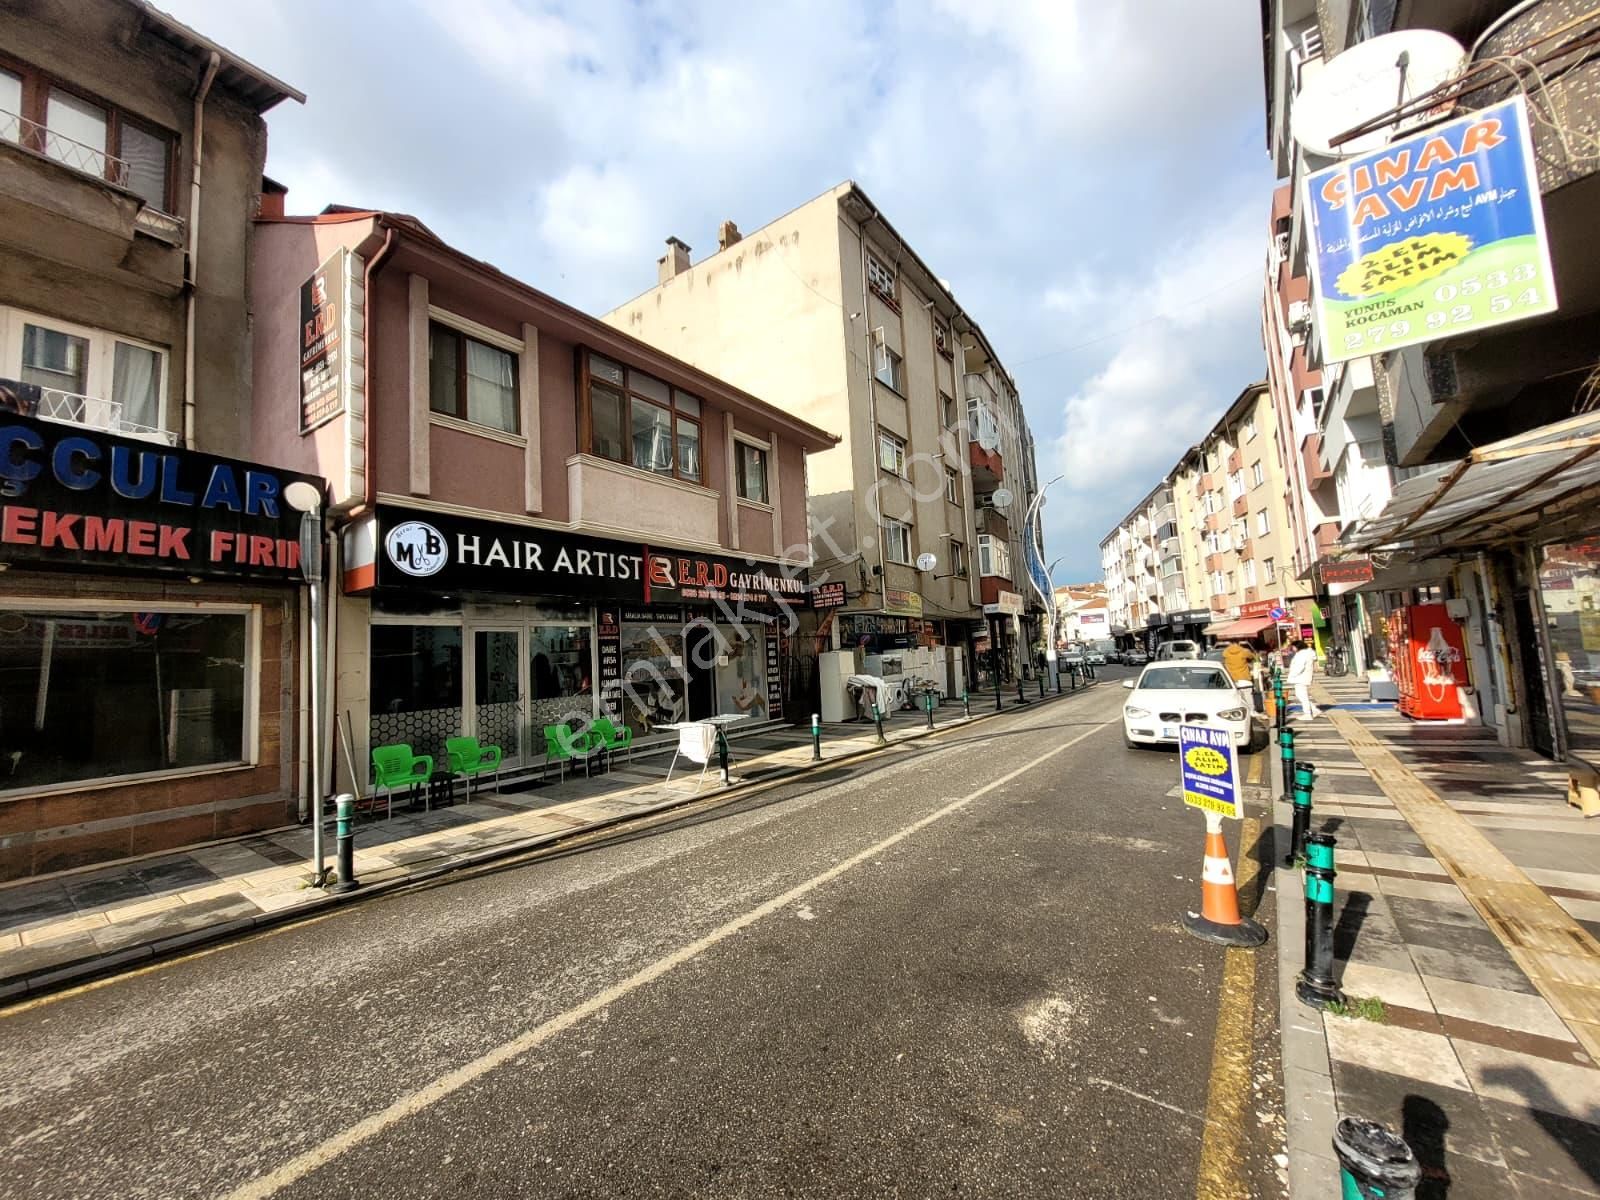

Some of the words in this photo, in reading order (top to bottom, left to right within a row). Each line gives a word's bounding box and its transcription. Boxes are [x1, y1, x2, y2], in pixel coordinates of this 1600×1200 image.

[1321, 118, 1507, 211] ÇINAR
[1352, 162, 1480, 226] AVM
[1475, 189, 1498, 205] AVM
[1361, 252, 1458, 292] SATIM
[1364, 246, 1442, 280] ALIM
[1433, 264, 1538, 304] 0533
[1344, 297, 1397, 319] YUNUS
[1344, 300, 1425, 328] KOCAMAN
[1344, 320, 1411, 350] 279
[1425, 304, 1473, 330] 92
[1489, 287, 1541, 314] 54
[1, 505, 192, 560] EKMEK
[456, 533, 544, 572] HAIR
[552, 546, 643, 581] ARTIST
